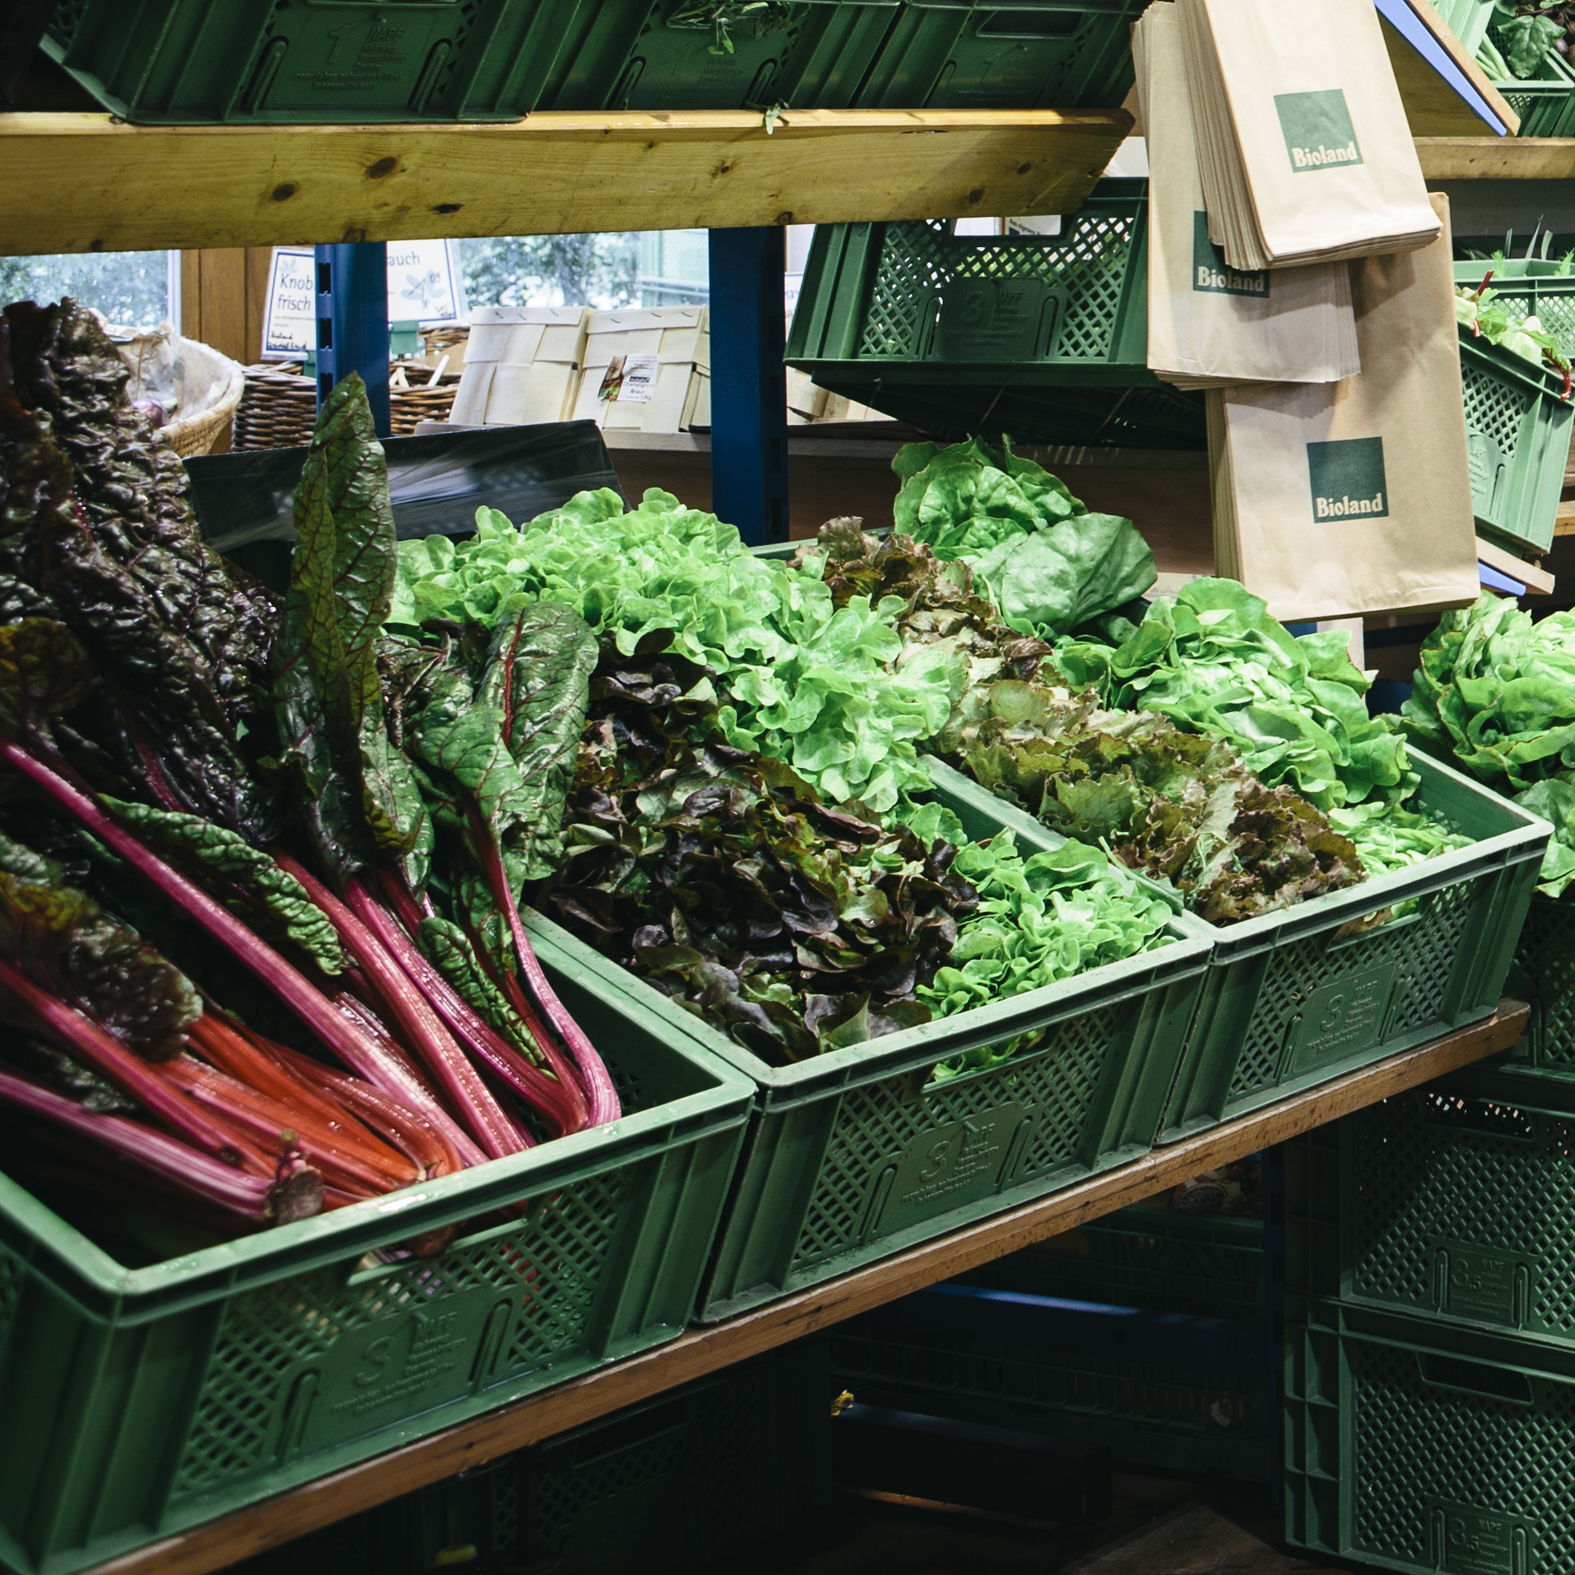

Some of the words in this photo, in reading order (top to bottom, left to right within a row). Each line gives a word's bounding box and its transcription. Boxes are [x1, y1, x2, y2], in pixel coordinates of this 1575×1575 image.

[1290, 139, 1359, 167] Bioland
[387, 251, 421, 269] auch
[280, 272, 314, 293] Knob
[1197, 265, 1266, 294] Bioland
[277, 294, 312, 313] frisch
[1315, 493, 1385, 518] Bioland
